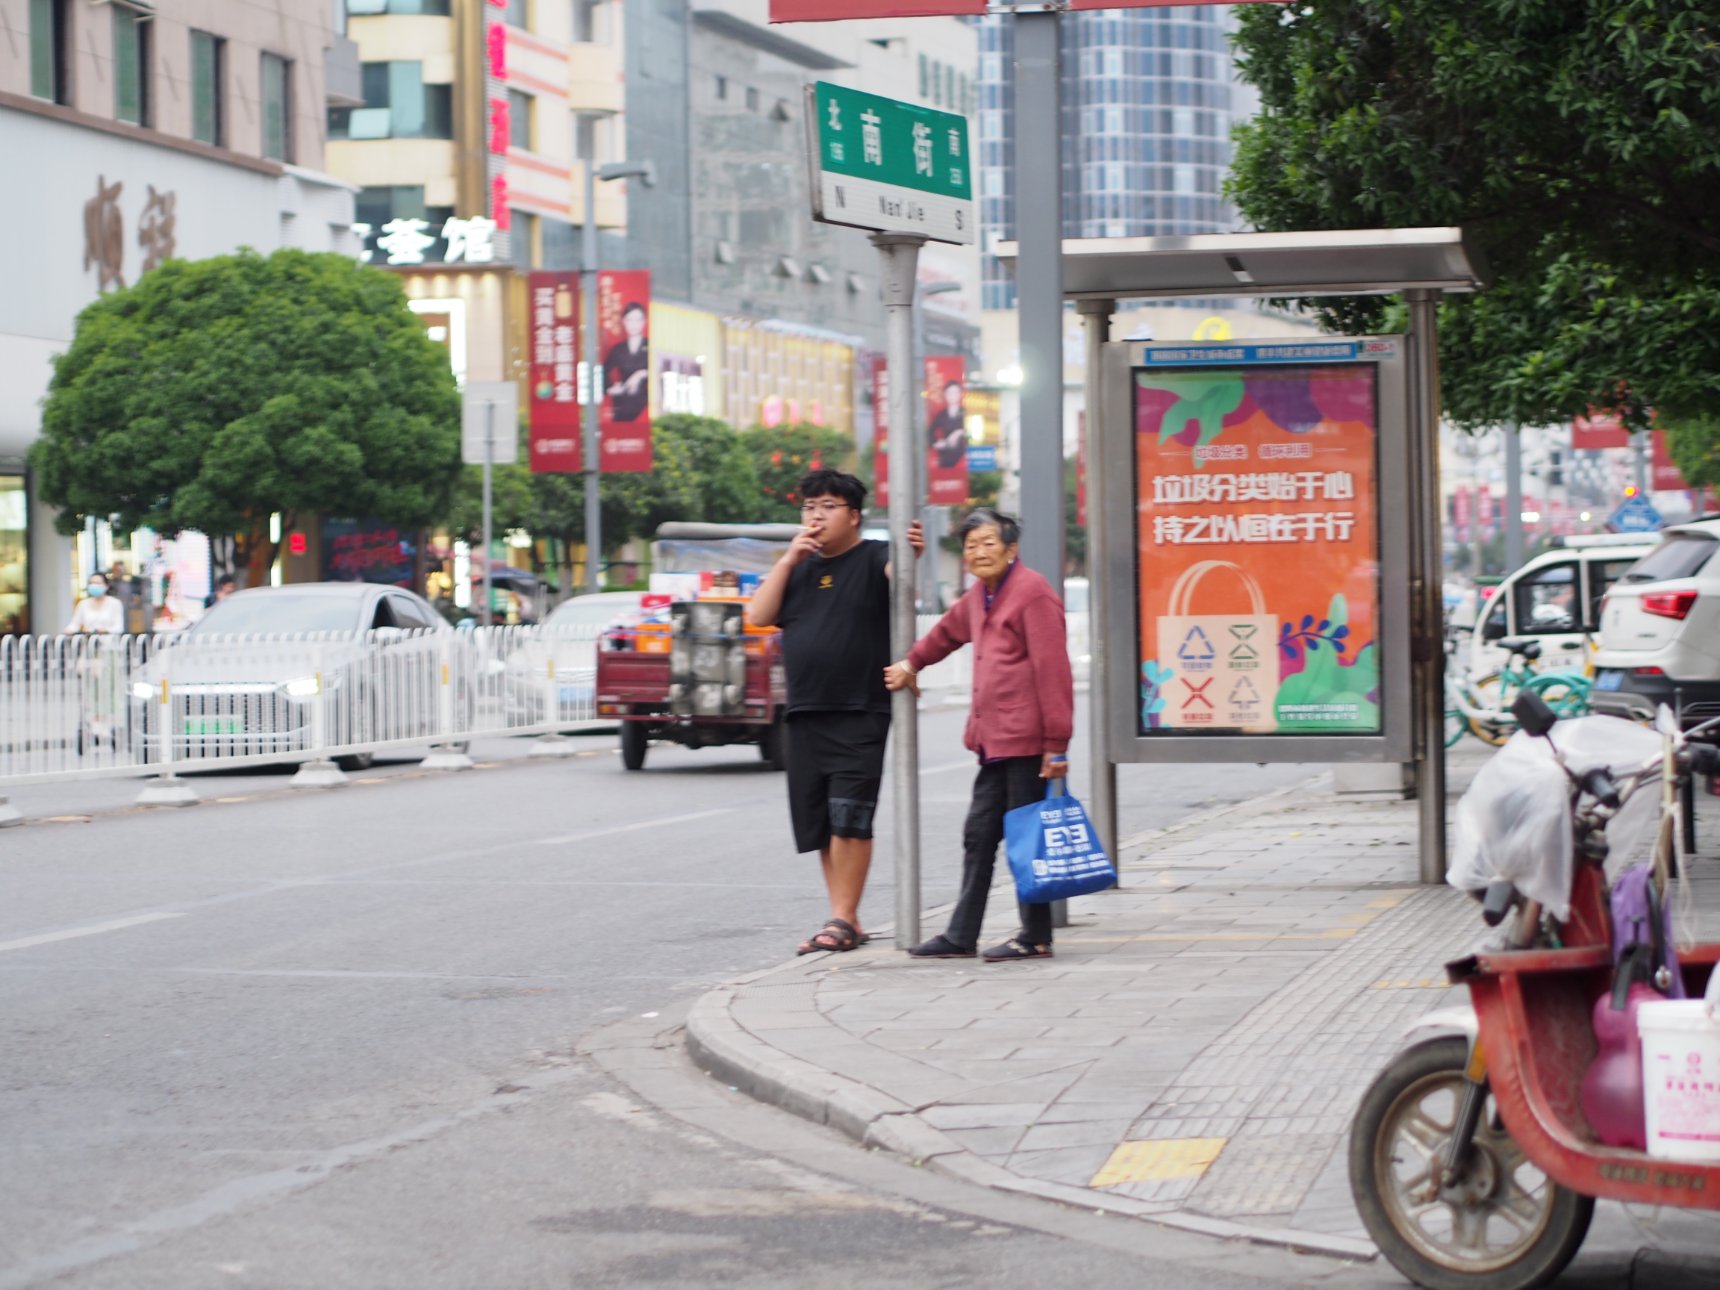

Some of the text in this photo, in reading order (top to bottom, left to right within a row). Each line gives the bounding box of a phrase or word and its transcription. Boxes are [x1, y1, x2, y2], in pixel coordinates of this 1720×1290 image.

[828, 98, 842, 131] 北
[860, 108, 934, 178] 南街
[835, 185, 846, 209] N
[906, 201, 925, 222] Jie
[954, 209, 965, 231] S
[1151, 470, 1355, 505] 垃圾分类始于心
[1152, 511, 1355, 544] 持之以恒在于行
